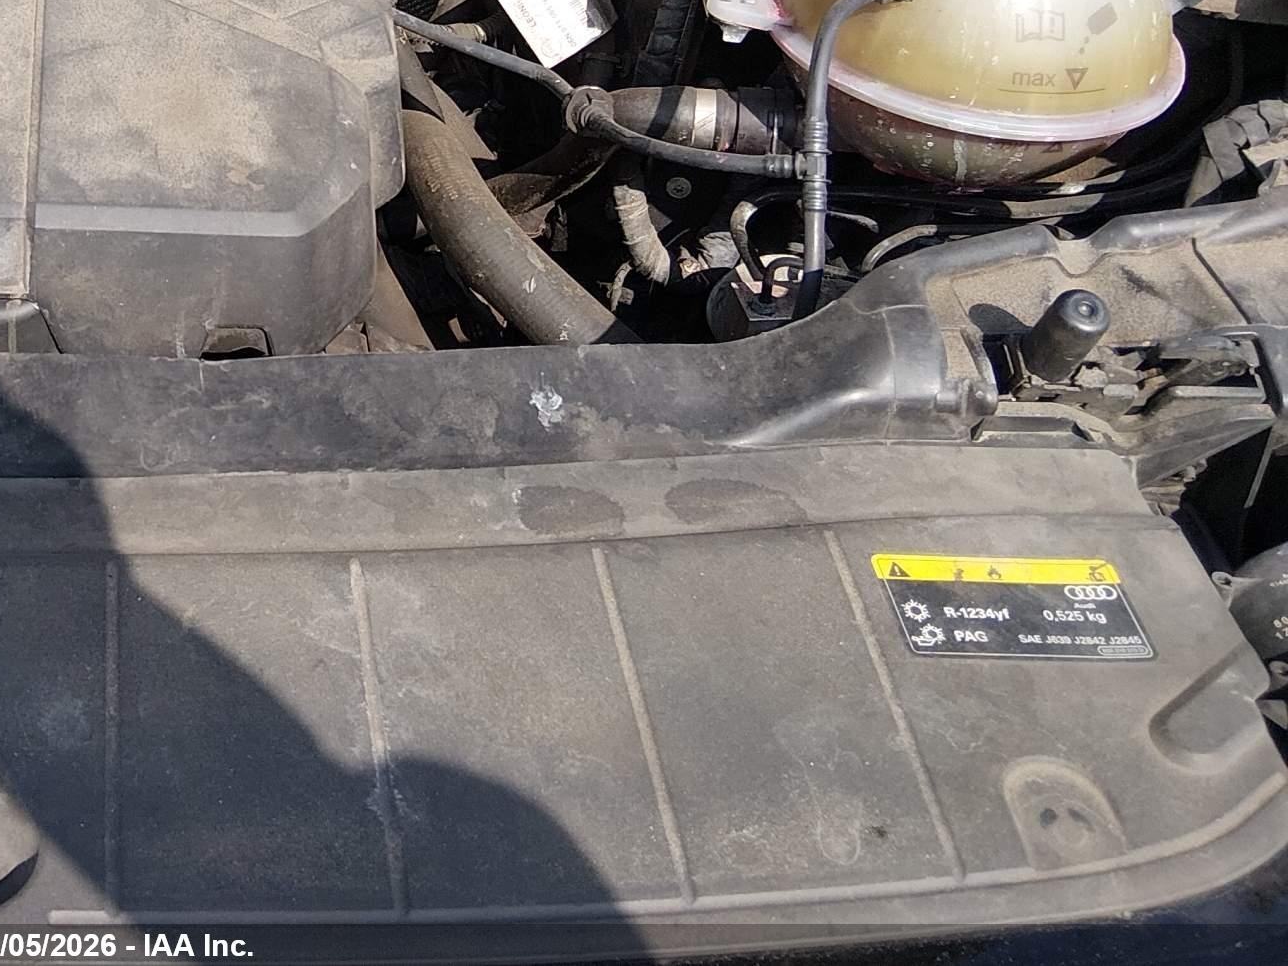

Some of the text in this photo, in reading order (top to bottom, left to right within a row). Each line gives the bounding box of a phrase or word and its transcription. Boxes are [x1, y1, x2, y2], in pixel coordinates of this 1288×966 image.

[1012, 71, 1056, 87] max
[944, 607, 1107, 624] R-1234yf 0,525 kg
[955, 630, 989, 643] PAG
[1018, 634, 1041, 644] SAE
